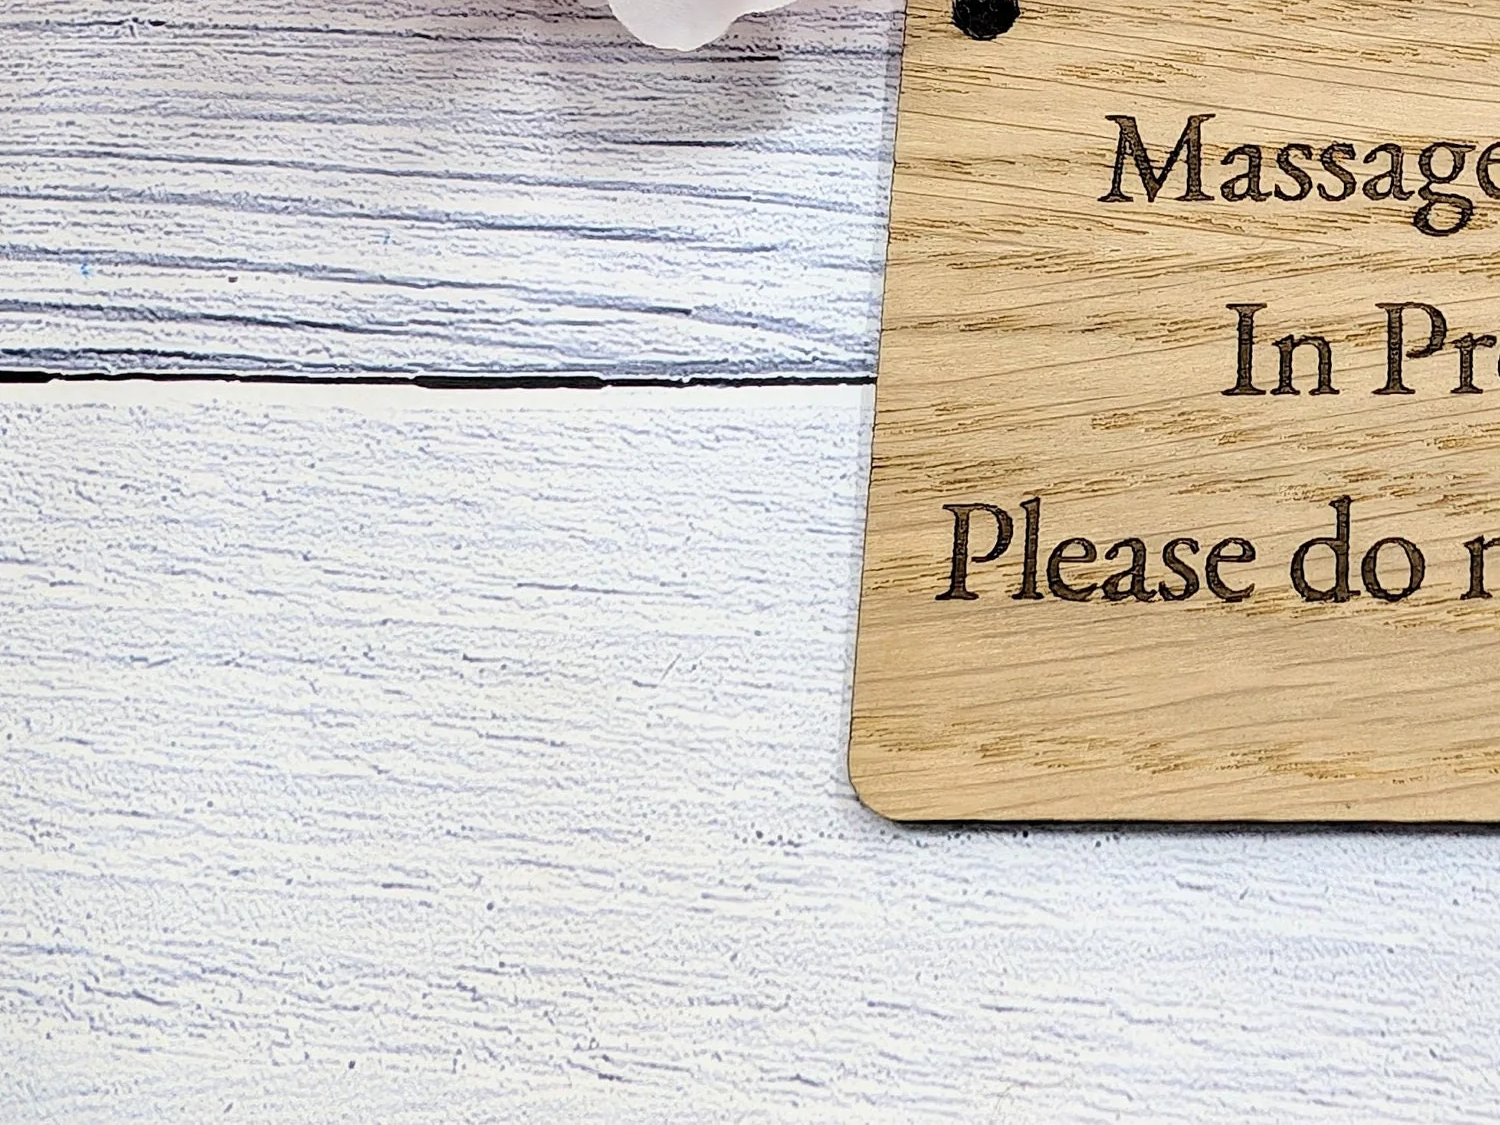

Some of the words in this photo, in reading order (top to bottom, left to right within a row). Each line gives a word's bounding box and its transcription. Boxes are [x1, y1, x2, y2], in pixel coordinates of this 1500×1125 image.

[1221, 302, 1338, 397] In
[935, 497, 1256, 603] Please
[1289, 495, 1426, 603] do
